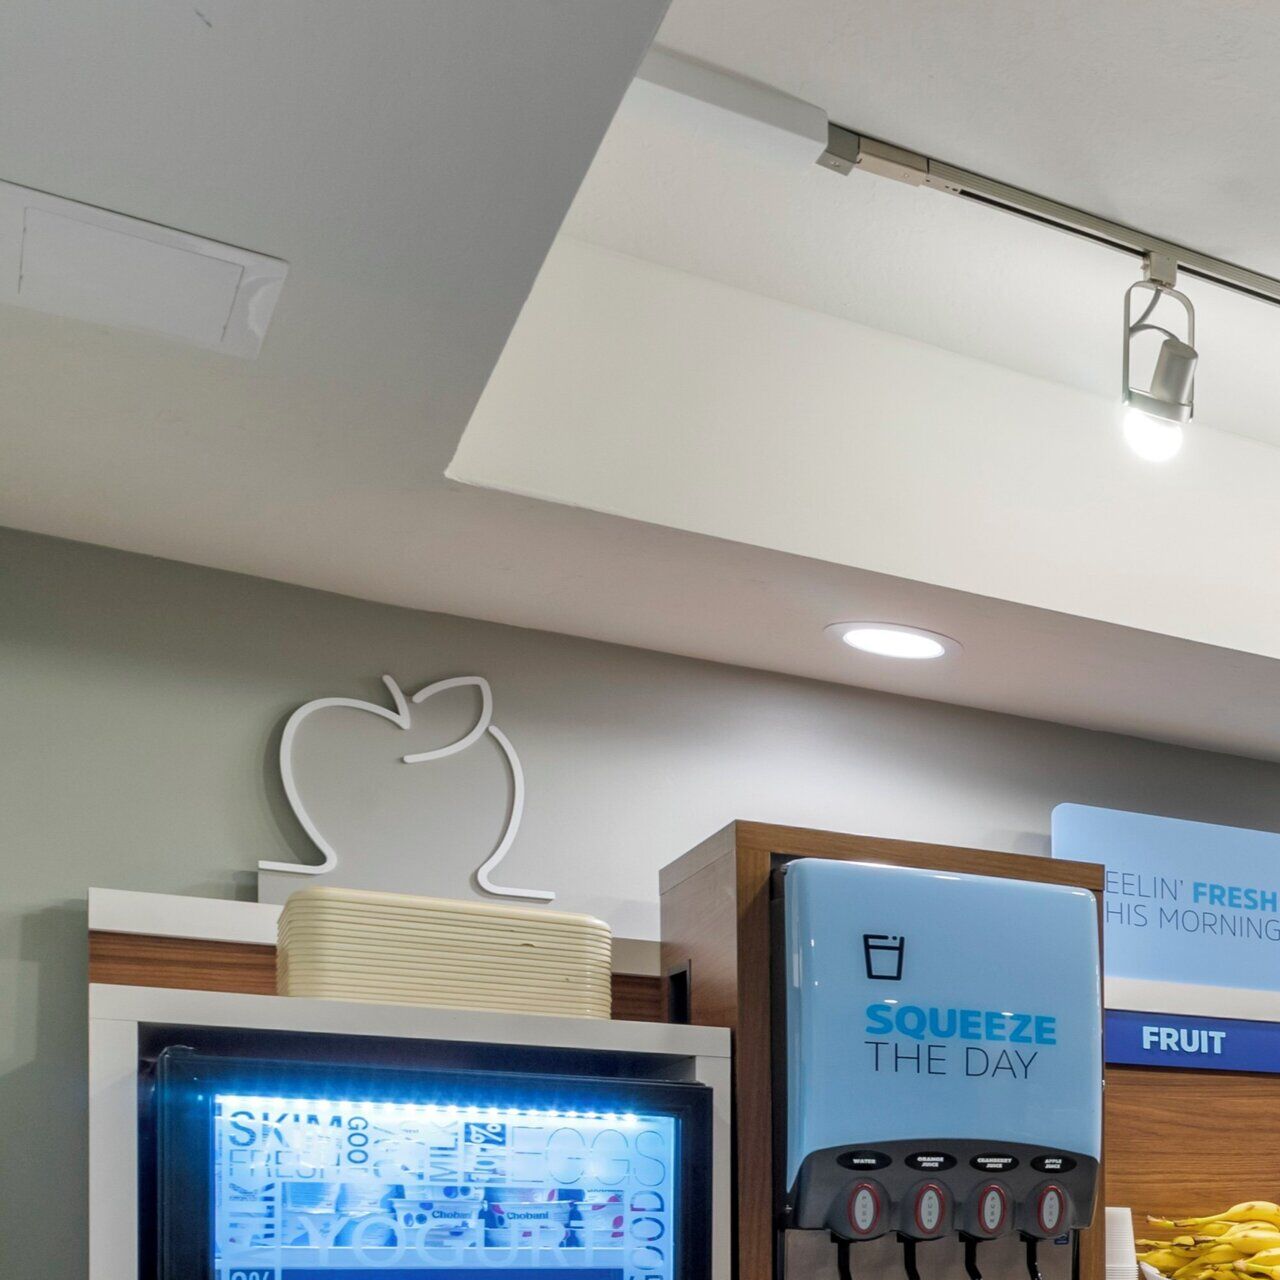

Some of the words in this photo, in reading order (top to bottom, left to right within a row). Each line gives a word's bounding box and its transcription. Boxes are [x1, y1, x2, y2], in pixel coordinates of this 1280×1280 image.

[1105, 870, 1184, 901] EELIN'
[1192, 881, 1278, 913] FRESH
[1105, 901, 1148, 928] HIS
[865, 1004, 1057, 1045] SQUEEZE
[1142, 1025, 1227, 1054] FRUIT
[864, 1040, 947, 1075] THE
[965, 1046, 1038, 1079] DAY
[228, 1111, 342, 1148] SK
[507, 1211, 549, 1220] Chobani
